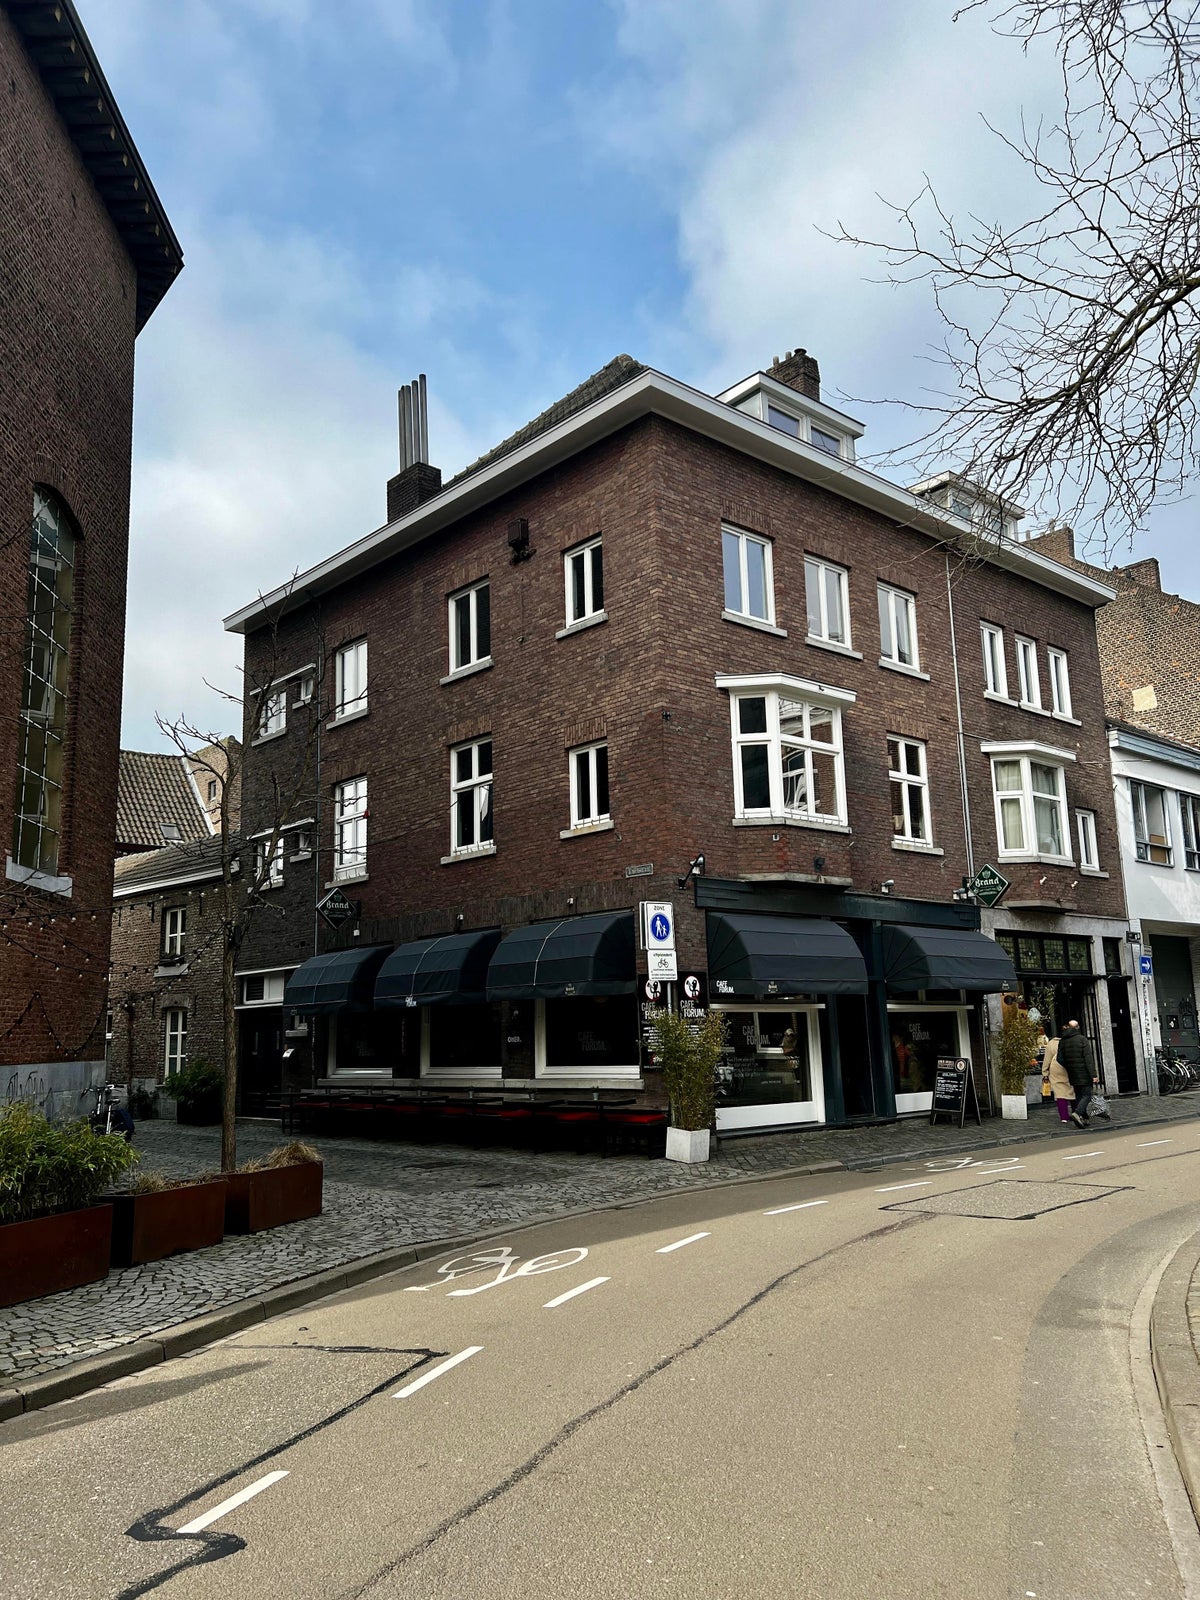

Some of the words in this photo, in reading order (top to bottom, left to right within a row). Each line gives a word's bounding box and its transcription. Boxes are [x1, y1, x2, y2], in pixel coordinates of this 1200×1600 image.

[975, 877, 1000, 888] Brand
[326, 900, 350, 910] Brand
[680, 1000, 695, 1009] CAFE
